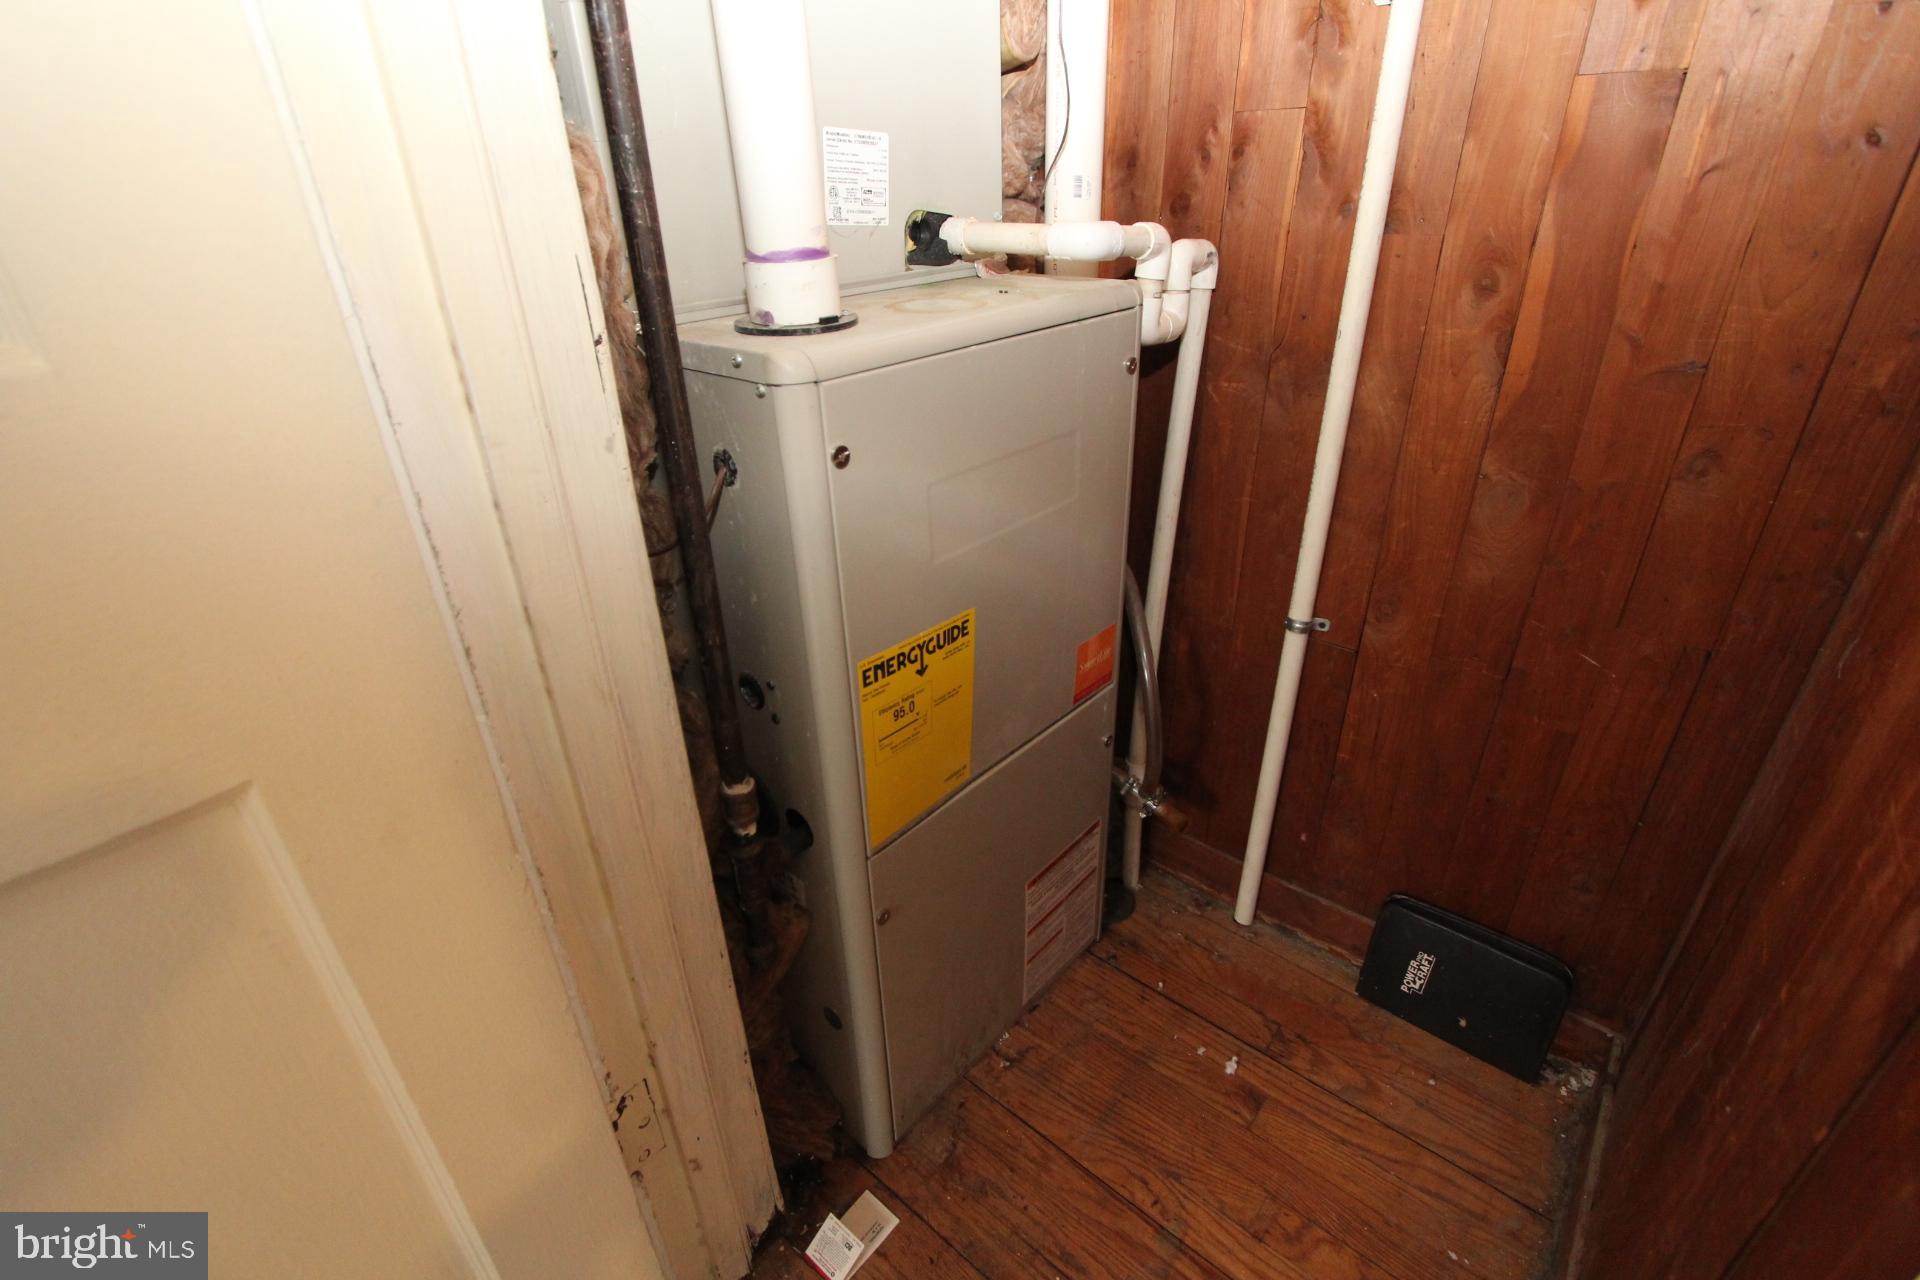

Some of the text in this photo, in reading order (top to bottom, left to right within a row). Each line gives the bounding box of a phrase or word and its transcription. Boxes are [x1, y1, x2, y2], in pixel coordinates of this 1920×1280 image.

[862, 619, 970, 688] ENERGYGUIDE
[893, 700, 915, 722] 95.0
[1401, 960, 1420, 993] POWER
[1415, 953, 1433, 986] CRAFT
